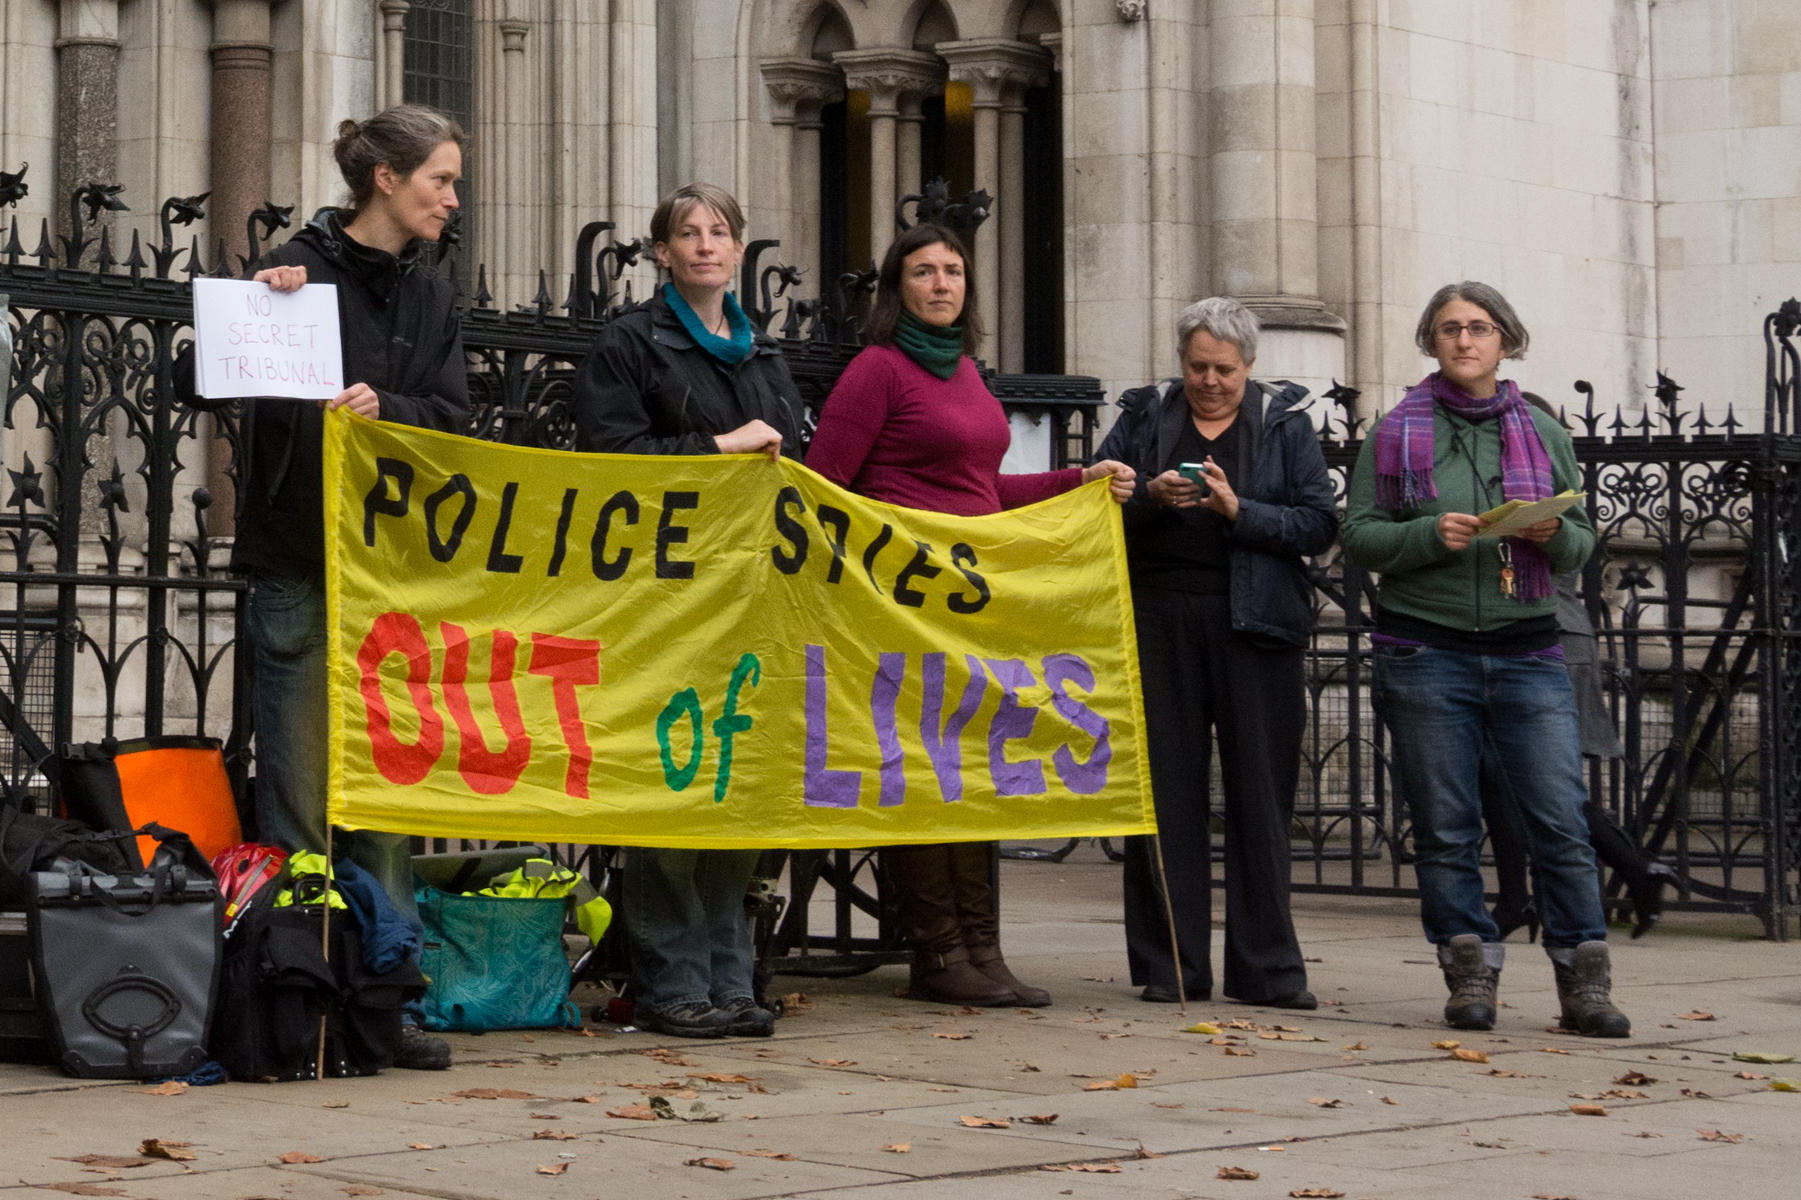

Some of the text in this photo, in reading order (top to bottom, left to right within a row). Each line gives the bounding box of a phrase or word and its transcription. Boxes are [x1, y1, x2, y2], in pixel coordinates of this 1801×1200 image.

[246, 293, 272, 317] NO
[228, 322, 319, 348] SECRET
[218, 355, 336, 386] TRIBUNAL
[362, 456, 992, 615] POLICE SPIES
[357, 611, 1112, 809] OUT of LIVES
